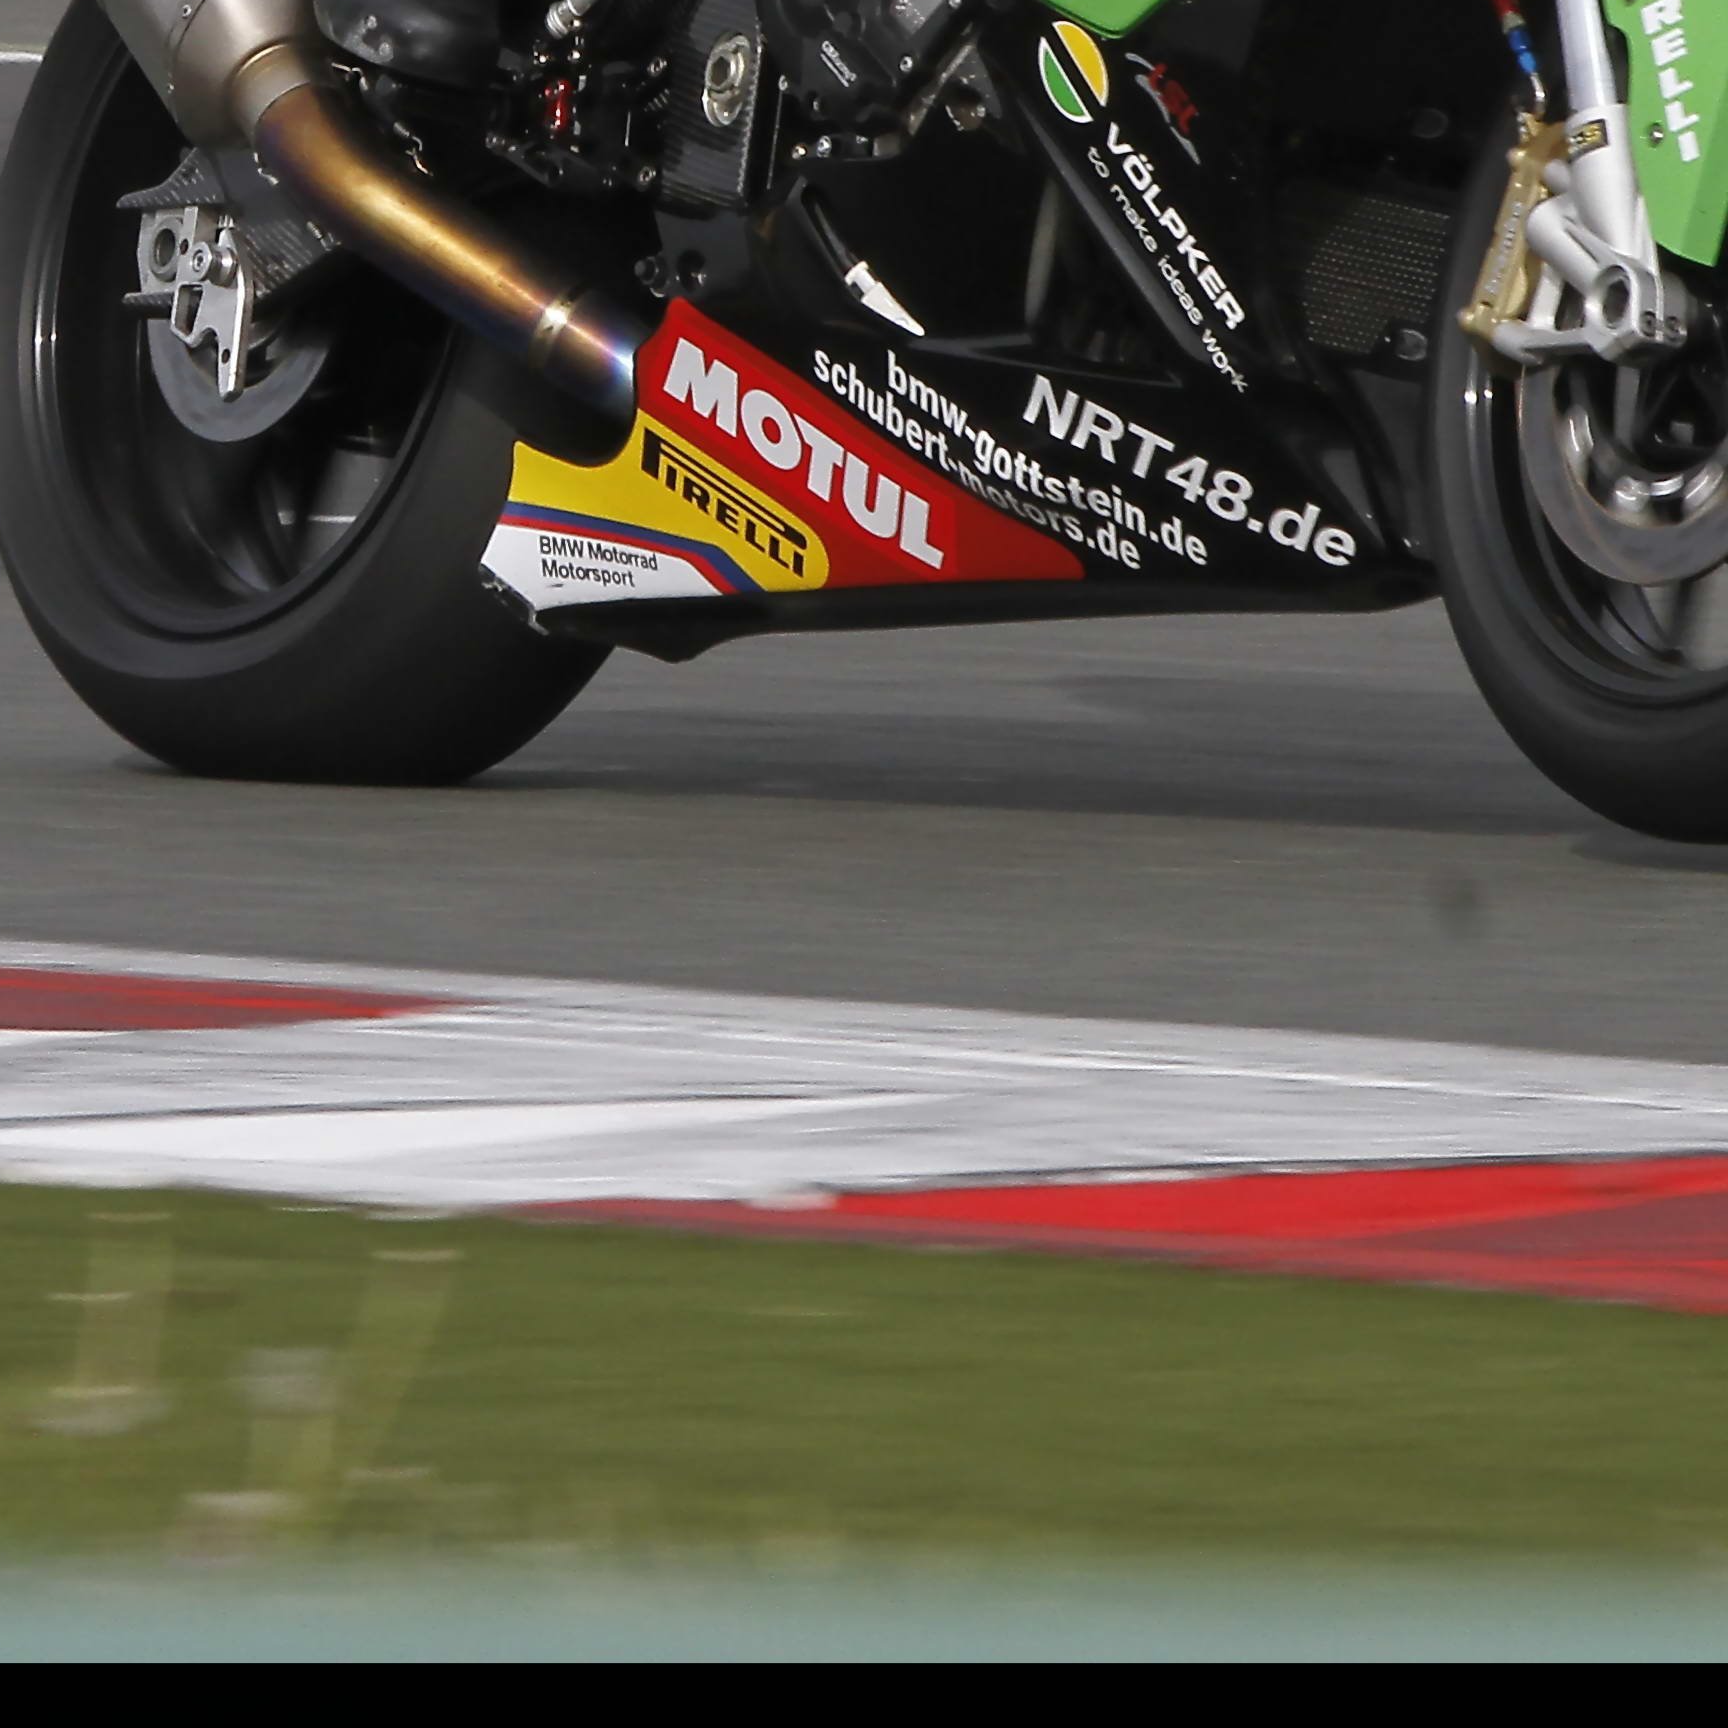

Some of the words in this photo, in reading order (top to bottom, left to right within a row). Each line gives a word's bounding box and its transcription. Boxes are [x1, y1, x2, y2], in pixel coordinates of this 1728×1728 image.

[1087, 146, 1110, 178] to
[1109, 184, 1158, 254] make
[1157, 254, 1204, 325] ideas
[1202, 328, 1249, 393] work
[1106, 121, 1245, 331] VÖLPKER
[539, 534, 585, 558] BMW
[587, 540, 659, 571] Motorrad
[640, 427, 808, 579] PIRELLI
[663, 336, 945, 570] MOTUL
[813, 348, 1142, 570] schubert-motors.de
[886, 349, 1208, 567] bmw-gottstein.de
[1022, 373, 1358, 566] NRT48.de
[540, 558, 636, 588] Motorsport
